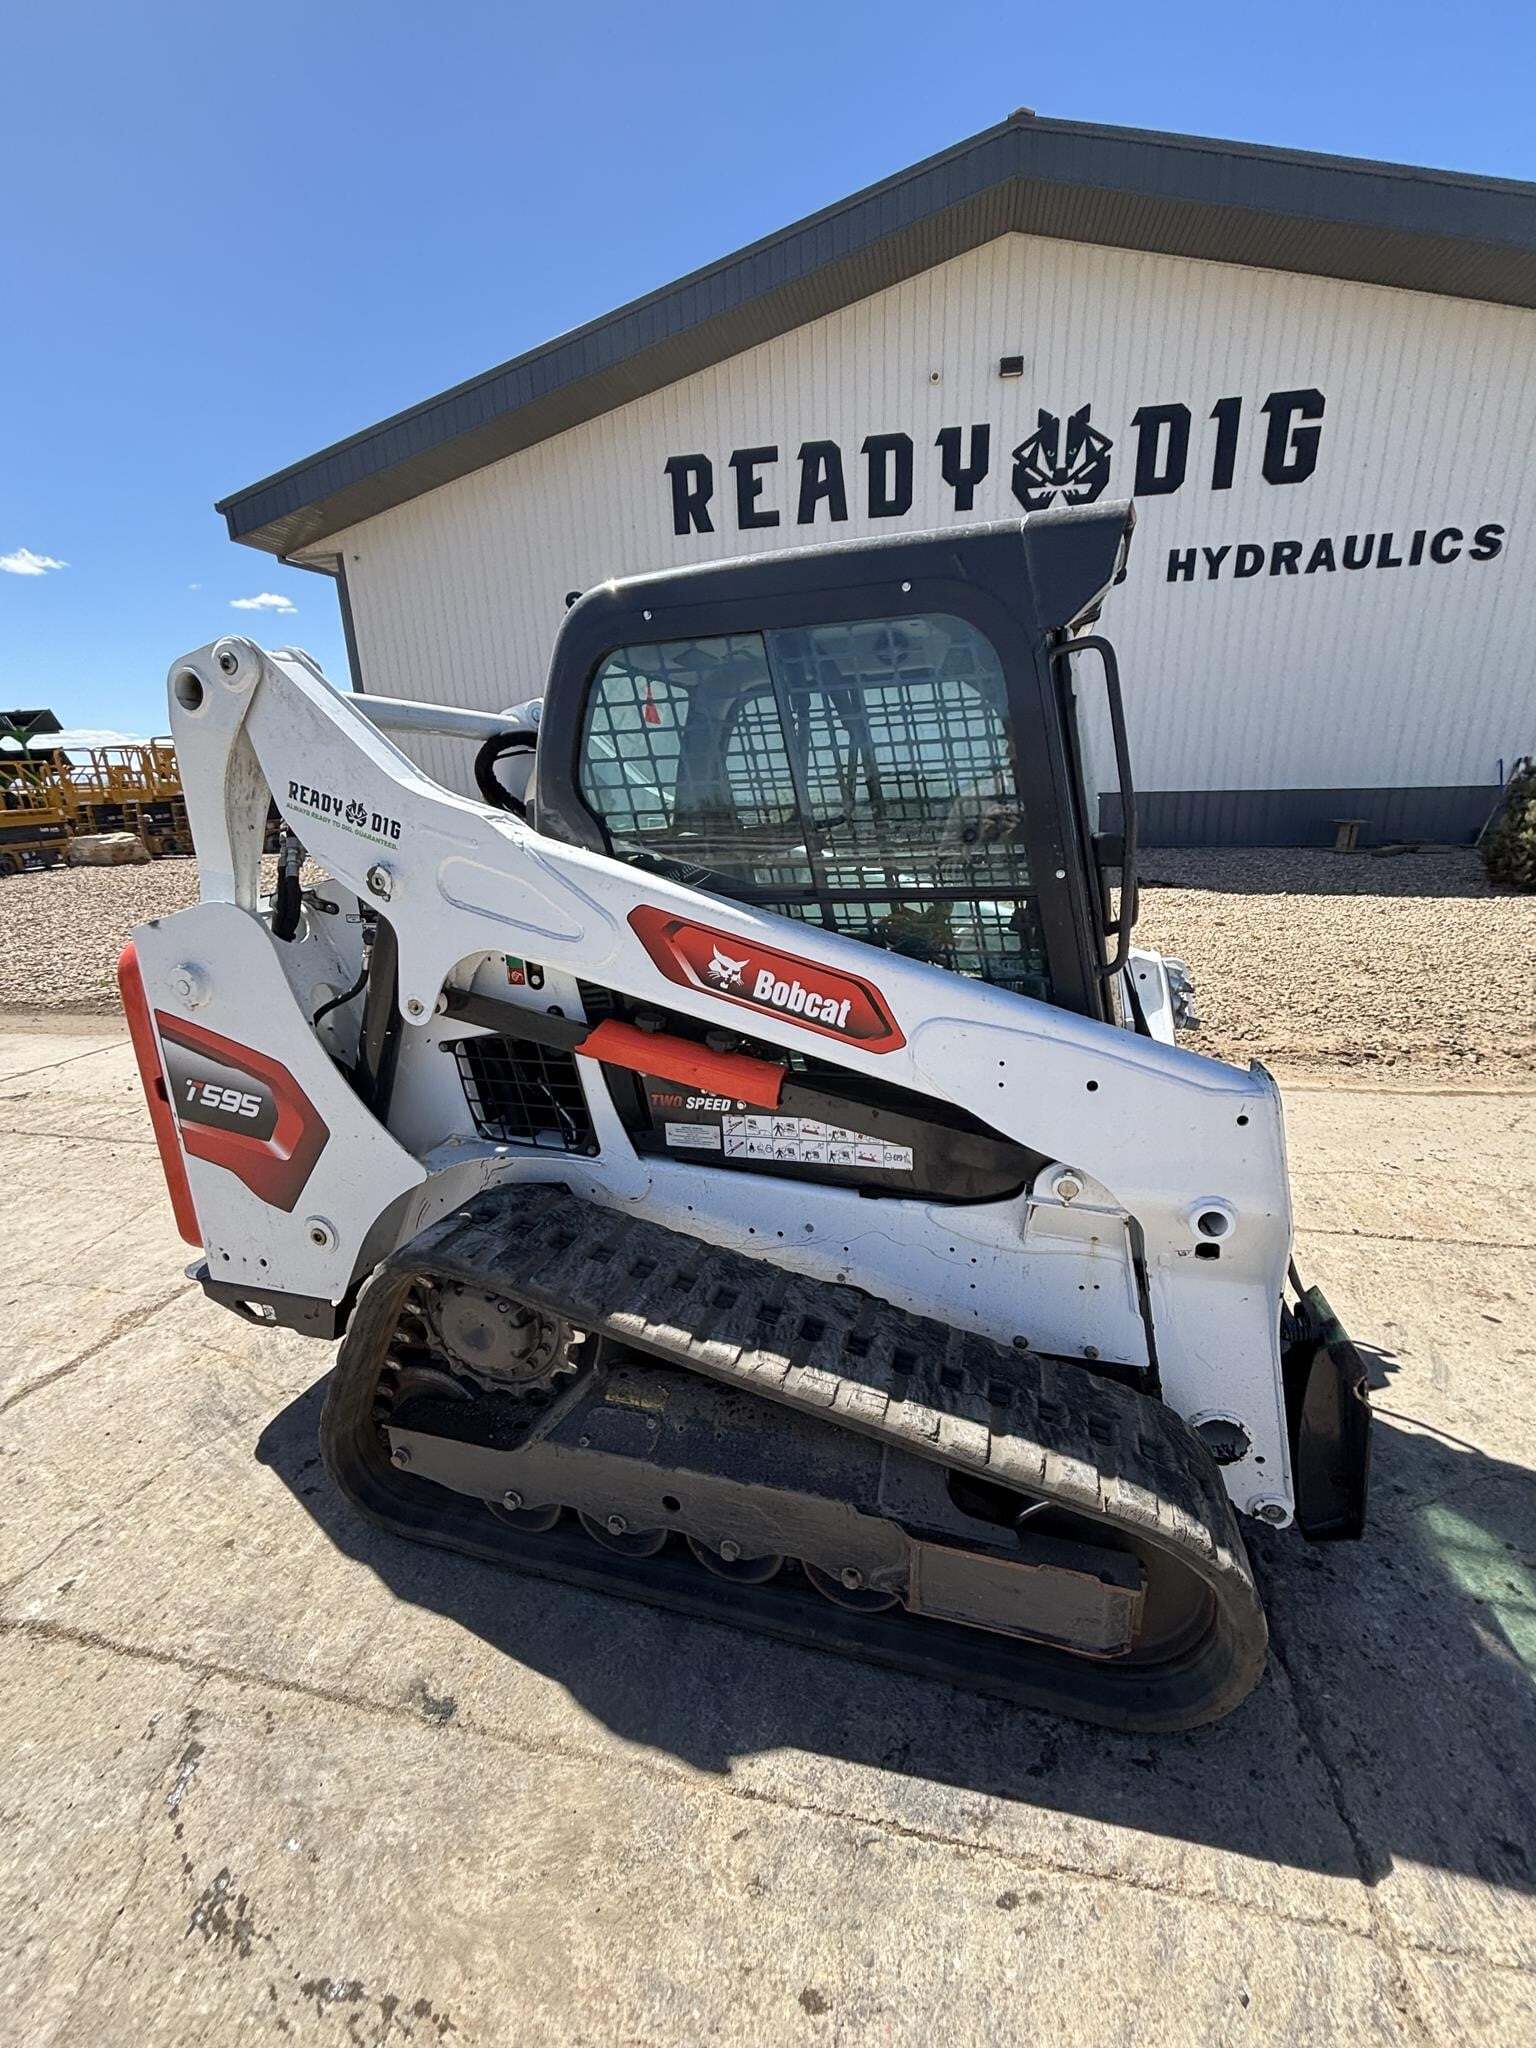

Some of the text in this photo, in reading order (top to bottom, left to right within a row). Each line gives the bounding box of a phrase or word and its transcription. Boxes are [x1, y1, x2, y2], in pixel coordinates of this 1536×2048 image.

[664, 388, 1326, 536] READY DIG
[1166, 523, 1506, 582] HYDRAULICS
[289, 781, 401, 840] READY DIG
[753, 969, 852, 1028] Bobcat
[651, 1094, 732, 1111] TWO SPEED
